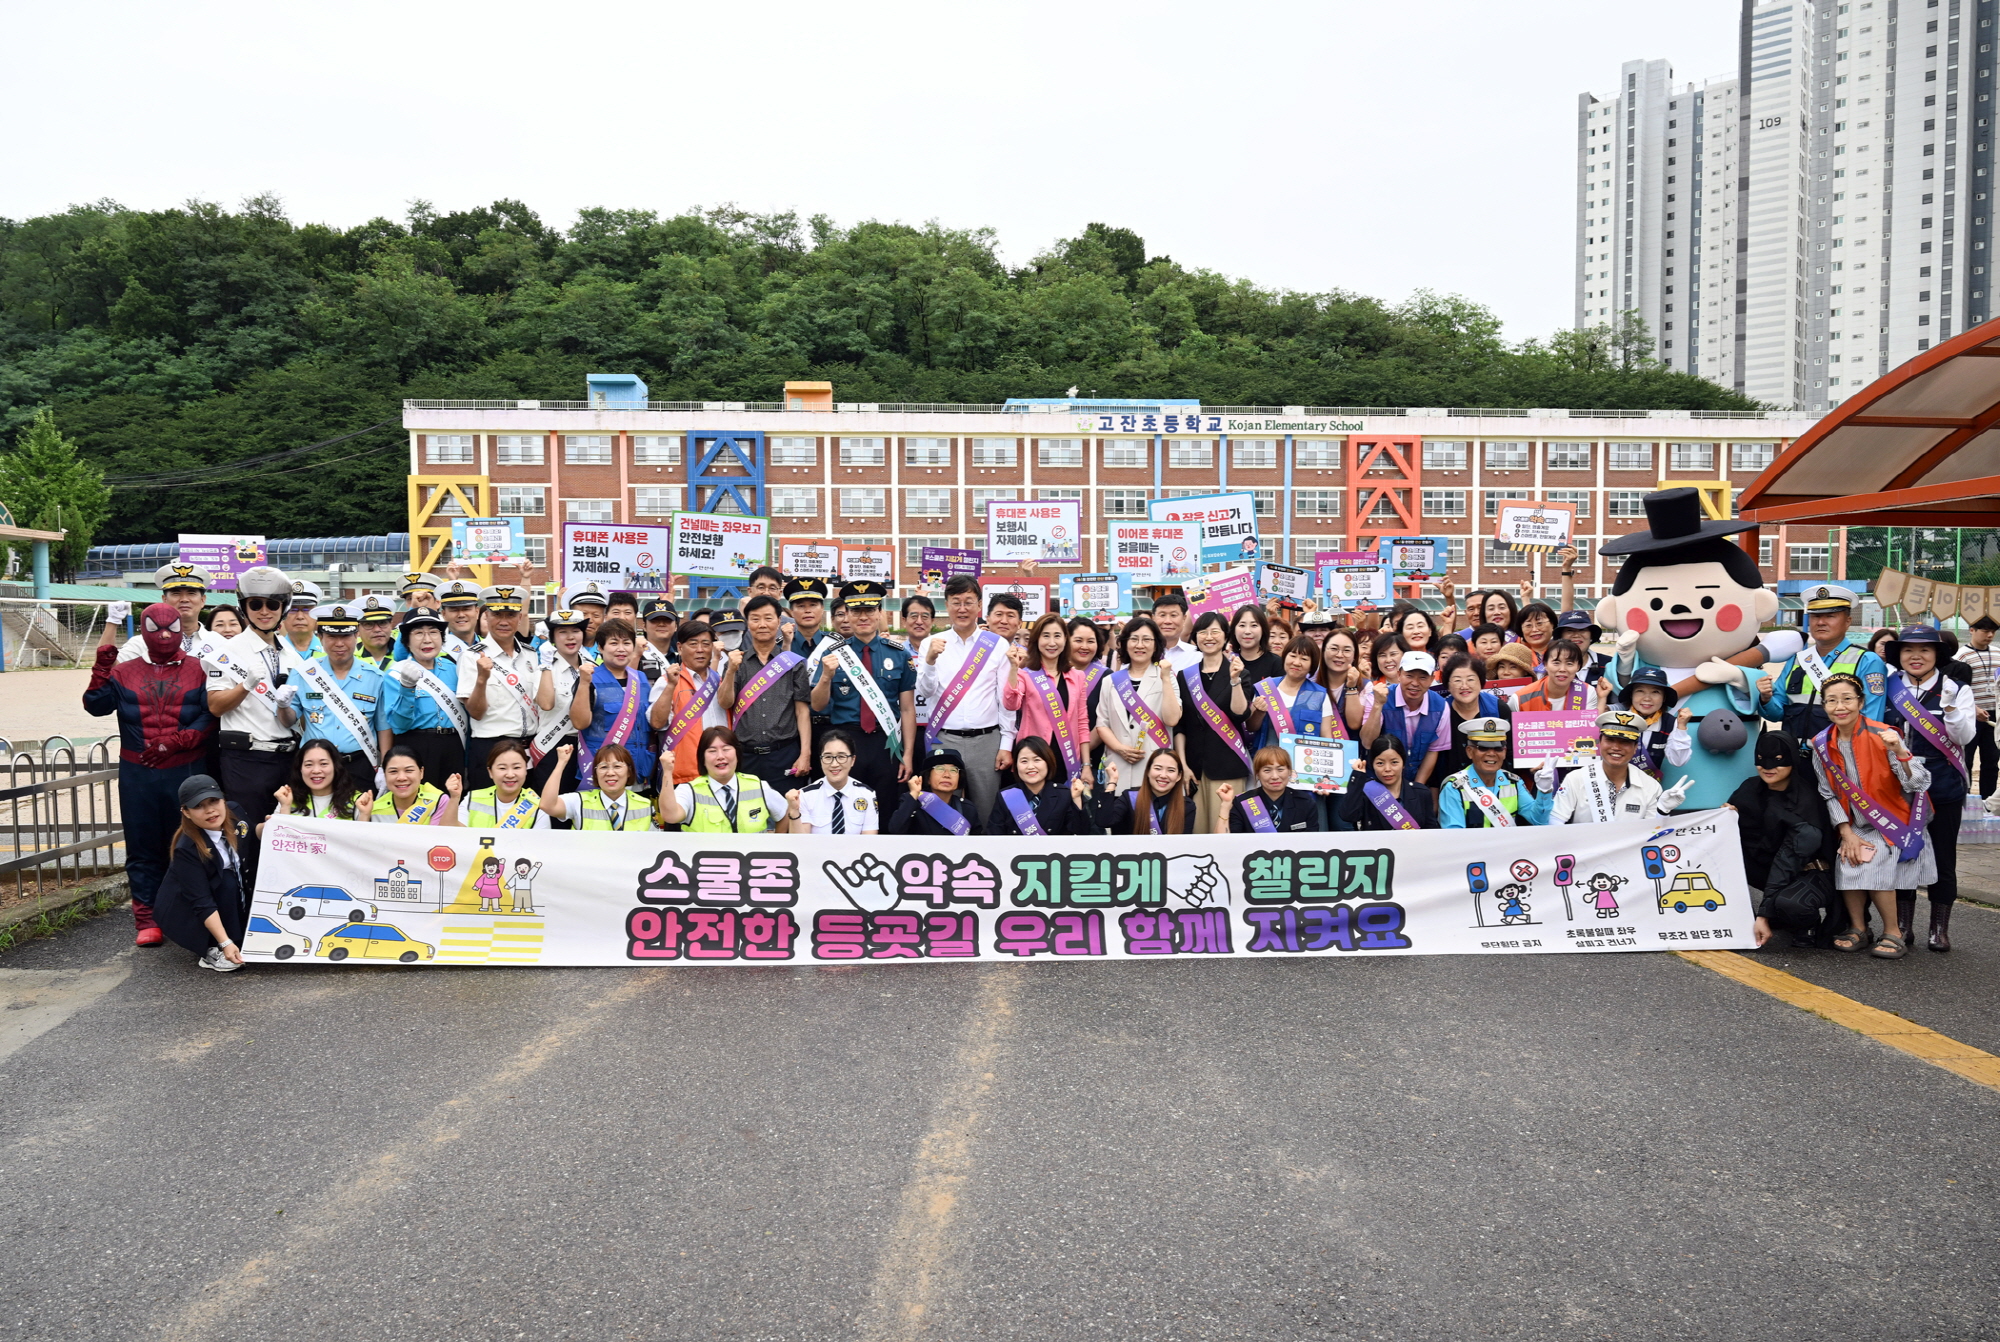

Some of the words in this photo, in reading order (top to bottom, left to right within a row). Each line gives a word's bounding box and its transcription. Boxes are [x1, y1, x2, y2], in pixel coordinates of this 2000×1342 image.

[1760, 117, 1781, 130] 109
[1098, 415, 1224, 432] 고잔초등학교
[1228, 420, 1262, 432] Kojan
[1265, 420, 1326, 432] Elementary
[1329, 420, 1364, 432] School
[996, 508, 1026, 518] 휴대폰
[1030, 508, 1060, 518] 사용은
[1208, 508, 1241, 522] 신고가
[680, 518, 720, 532] 건널때는
[722, 522, 761, 534] 좌우보고
[996, 521, 1027, 532] 보행시
[1208, 522, 1252, 538] 만듭니다
[573, 530, 609, 543] 휴대폰
[612, 532, 648, 544] 사용은
[680, 532, 724, 546] 안전보행
[1118, 528, 1148, 539] 이어폰
[1152, 528, 1184, 539] 휴대폰
[996, 534, 1038, 546] 자제해요
[573, 546, 609, 558] 보행시
[678, 547, 716, 560] 하세요!
[1118, 542, 1160, 553] 걸을때는
[572, 561, 620, 574] 자제해요
[1118, 556, 1152, 568] 안돼요!
[1547, 720, 1564, 728] 약속
[1565, 720, 1587, 728] 챌린지
[1675, 825, 1716, 836] 안산시
[272, 840, 308, 854] 안전한
[310, 842, 327, 854] 家!
[1664, 849, 1676, 857] 30
[641, 853, 797, 904] 스쿨존
[899, 856, 999, 907] 약속
[1014, 855, 1164, 905] 지킬게
[1246, 853, 1391, 902] 챌린지
[629, 910, 797, 959] 안전한
[813, 912, 978, 958] 등굣길
[997, 911, 1104, 955] 우리
[1121, 909, 1232, 953] 함께
[1245, 904, 1409, 951] 지켜요
[1566, 927, 1615, 938] 초록불일때
[1617, 926, 1637, 936] 좌우
[1658, 931, 1688, 941] 무조건
[1690, 930, 1710, 939] 일단
[1712, 929, 1733, 939] 정지
[1481, 940, 1520, 949] 무단횡단
[1523, 939, 1542, 948] 금지
[1575, 939, 1604, 948] 살피고
[1607, 938, 1637, 947] 건너기
